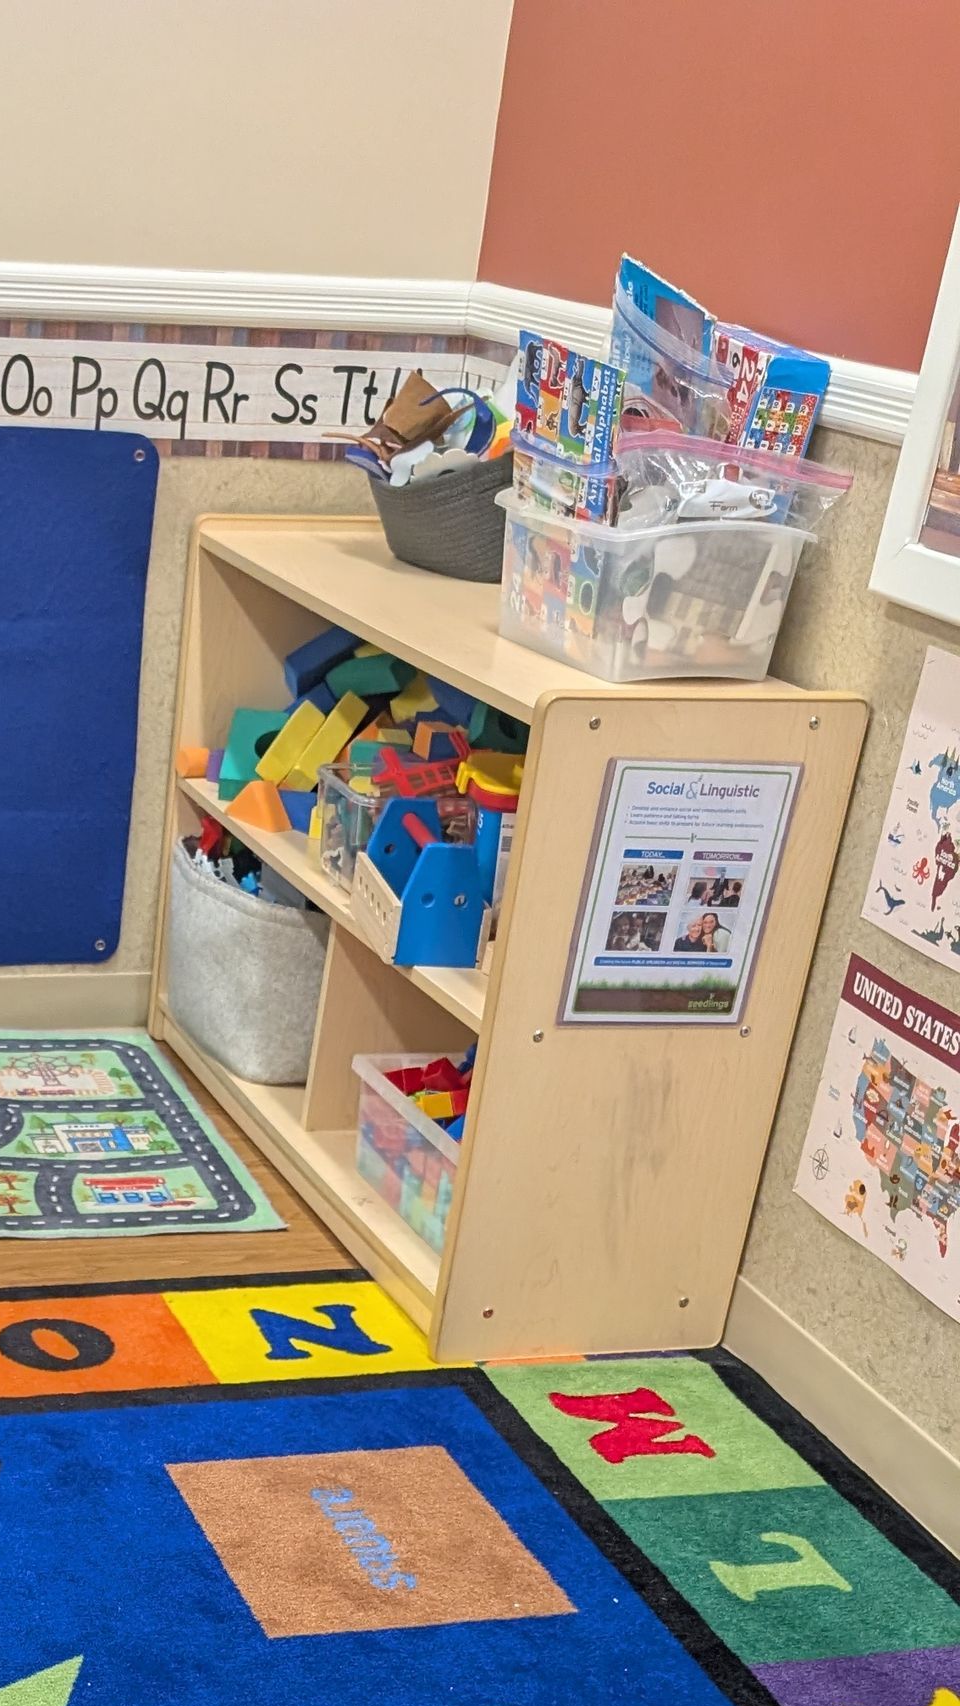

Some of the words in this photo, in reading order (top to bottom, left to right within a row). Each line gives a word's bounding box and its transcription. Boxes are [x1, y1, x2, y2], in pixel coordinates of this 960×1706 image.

[1, 354, 53, 417] Oo
[70, 356, 119, 430] Pp
[133, 358, 189, 440] Qq
[202, 361, 250, 424] Rr
[271, 363, 318, 425] Ss
[333, 366, 378, 426] Tt
[737, 358, 755, 403] 24
[587, 449, 602, 506] Anial
[595, 369, 611, 444] Alphabet
[709, 501, 738, 512] Farm
[647, 781, 685, 796] Social
[699, 783, 760, 800] Linguistic
[687, 998, 729, 1011] seedlings
[853, 971, 903, 1020] UNITED
[903, 1004, 960, 1056] STATES
[250, 1304, 393, 1359] N
[548, 1387, 716, 1464] M
[310, 1487, 419, 1591] square
[709, 1531, 853, 1601] L
